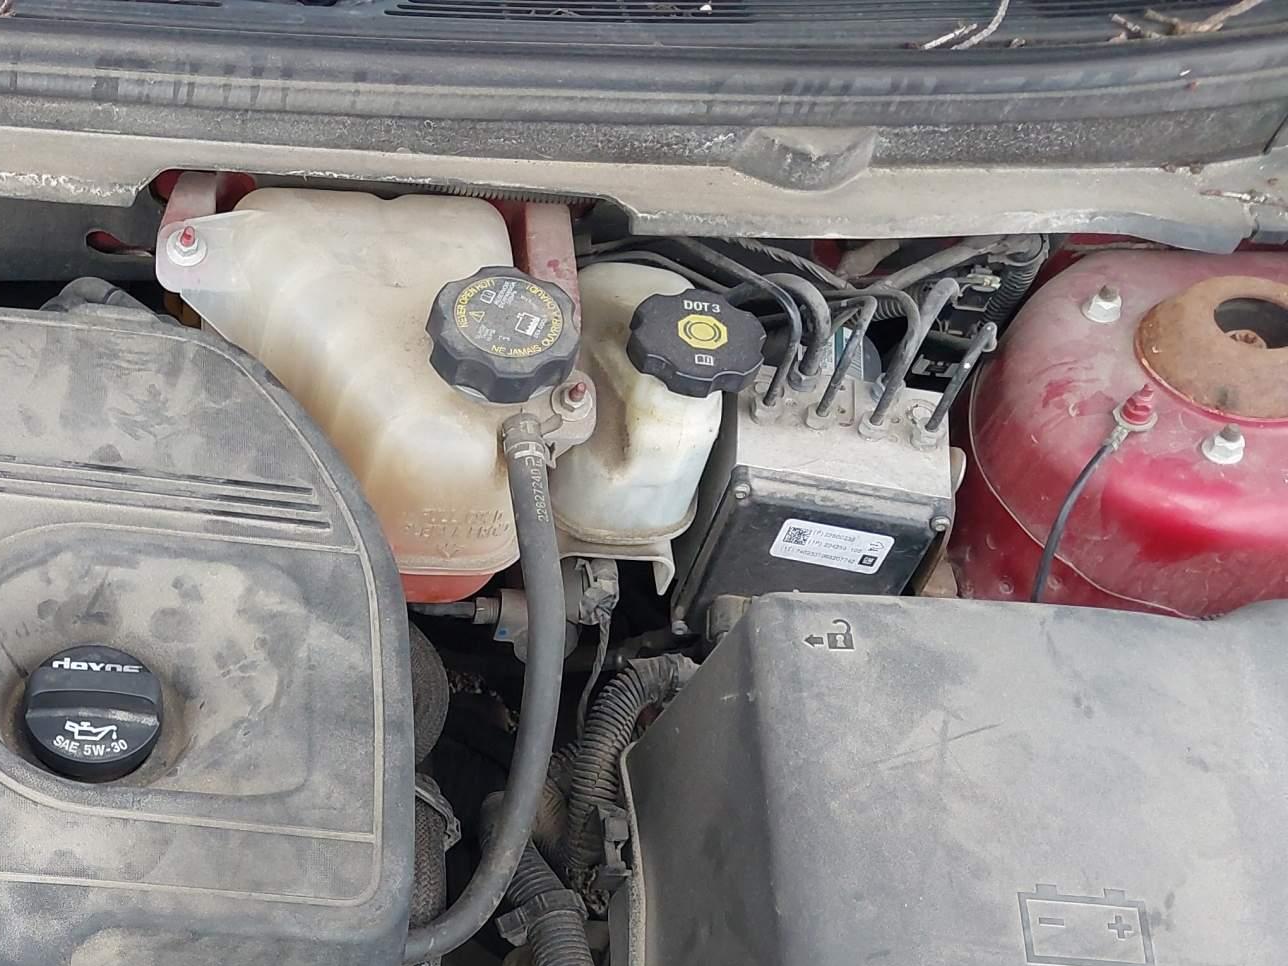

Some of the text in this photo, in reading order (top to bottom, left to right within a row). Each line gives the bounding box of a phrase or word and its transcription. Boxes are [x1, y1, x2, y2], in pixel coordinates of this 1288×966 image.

[683, 300, 720, 313] DOT 3
[53, 735, 128, 756] SAE 5W-30
